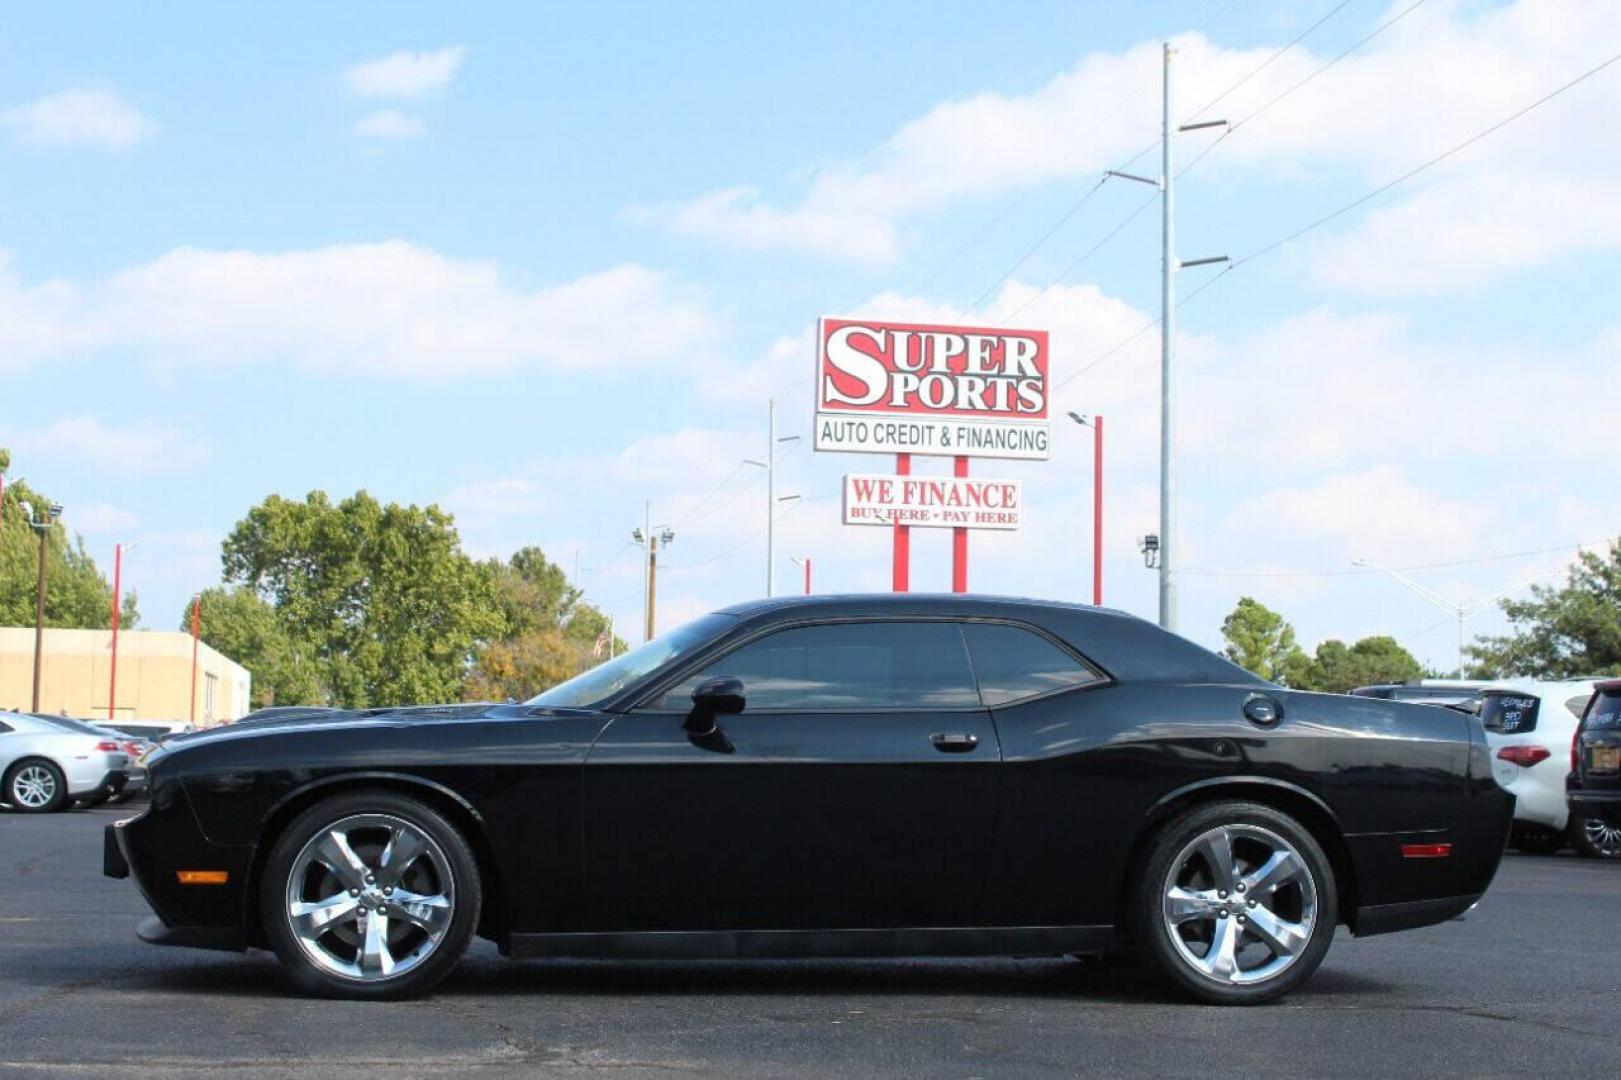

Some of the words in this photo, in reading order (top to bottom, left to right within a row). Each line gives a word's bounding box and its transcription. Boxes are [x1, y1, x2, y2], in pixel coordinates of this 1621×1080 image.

[826, 325, 1042, 406] SUPER
[822, 421, 868, 443] AUTO
[873, 423, 935, 446] CREDIT
[940, 428, 951, 447] &
[957, 427, 1047, 451] FINANCING
[852, 479, 894, 504] WE
[902, 480, 1017, 509] FINANCE
[851, 507, 882, 519] BUY
[886, 508, 930, 521] HERE
[943, 511, 971, 523] PAY
[975, 512, 1018, 524] HERE
